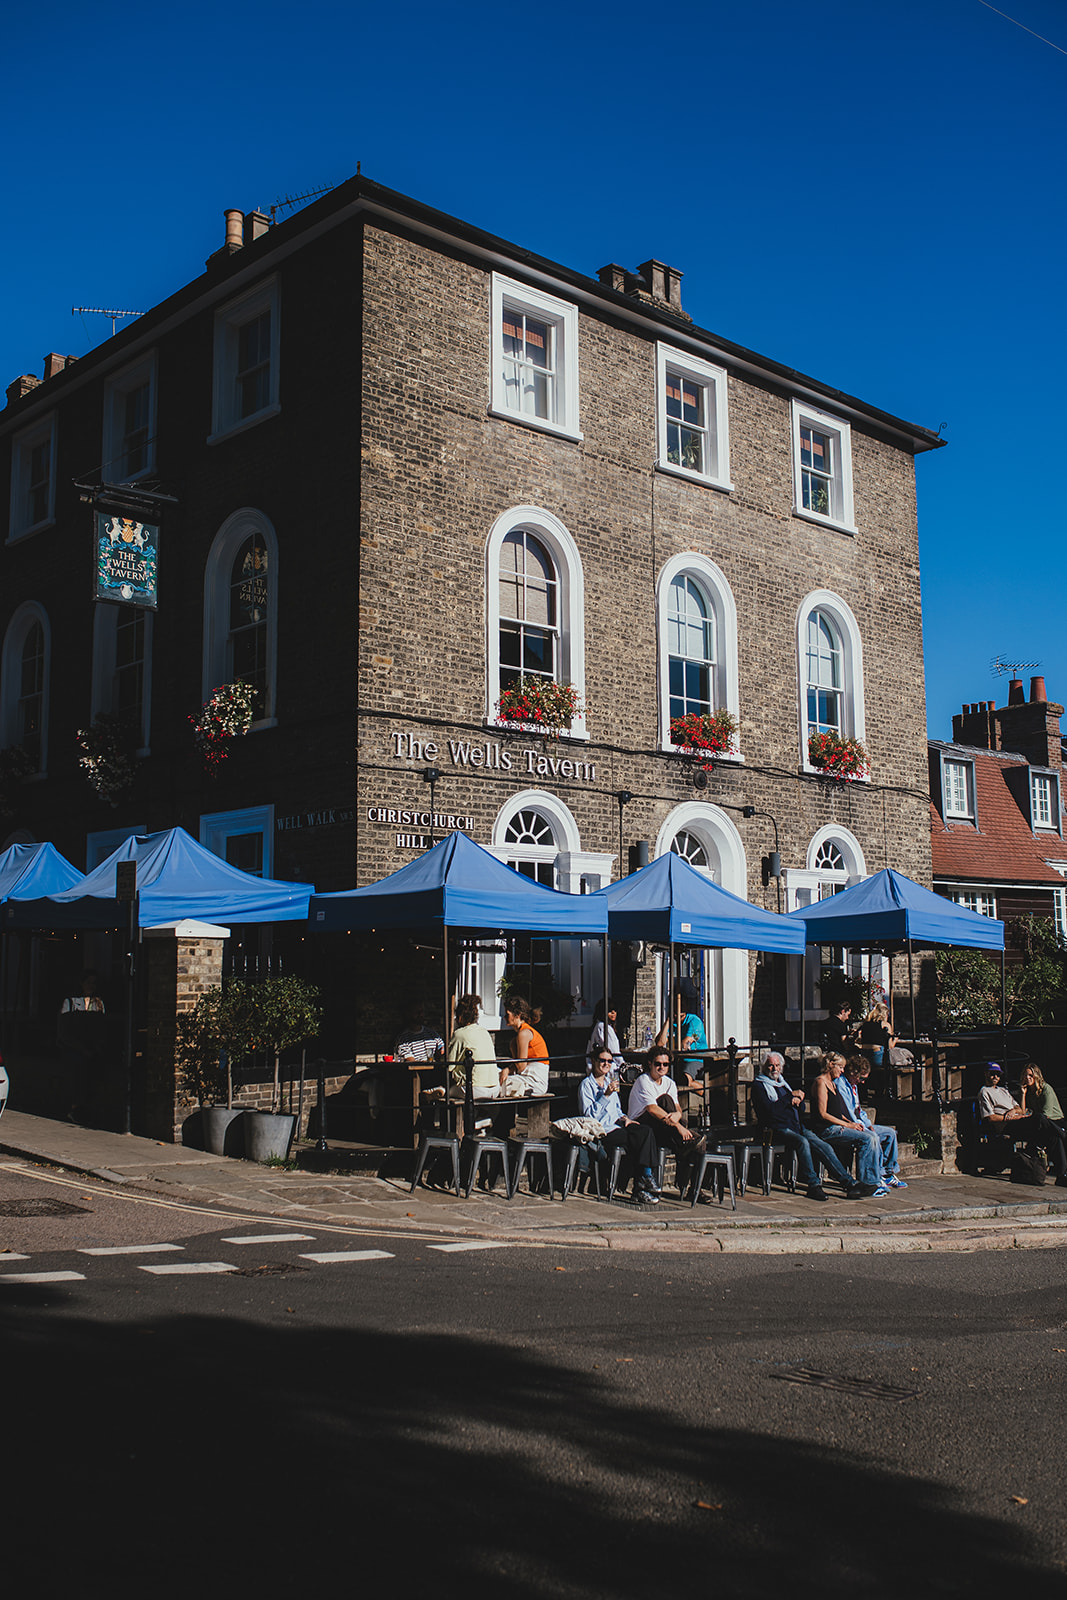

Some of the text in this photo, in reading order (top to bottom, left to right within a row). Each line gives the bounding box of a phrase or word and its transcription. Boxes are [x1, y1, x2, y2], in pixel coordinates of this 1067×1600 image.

[118, 550, 137, 562] THE
[111, 558, 145, 572] WELLS
[110, 567, 146, 581] TAVERN
[391, 732, 596, 781] The Wells Tavern
[276, 815, 303, 831] WELL
[306, 809, 336, 827] WALK
[367, 807, 474, 831] CHRISTCHURCH
[396, 833, 428, 849] HILL
